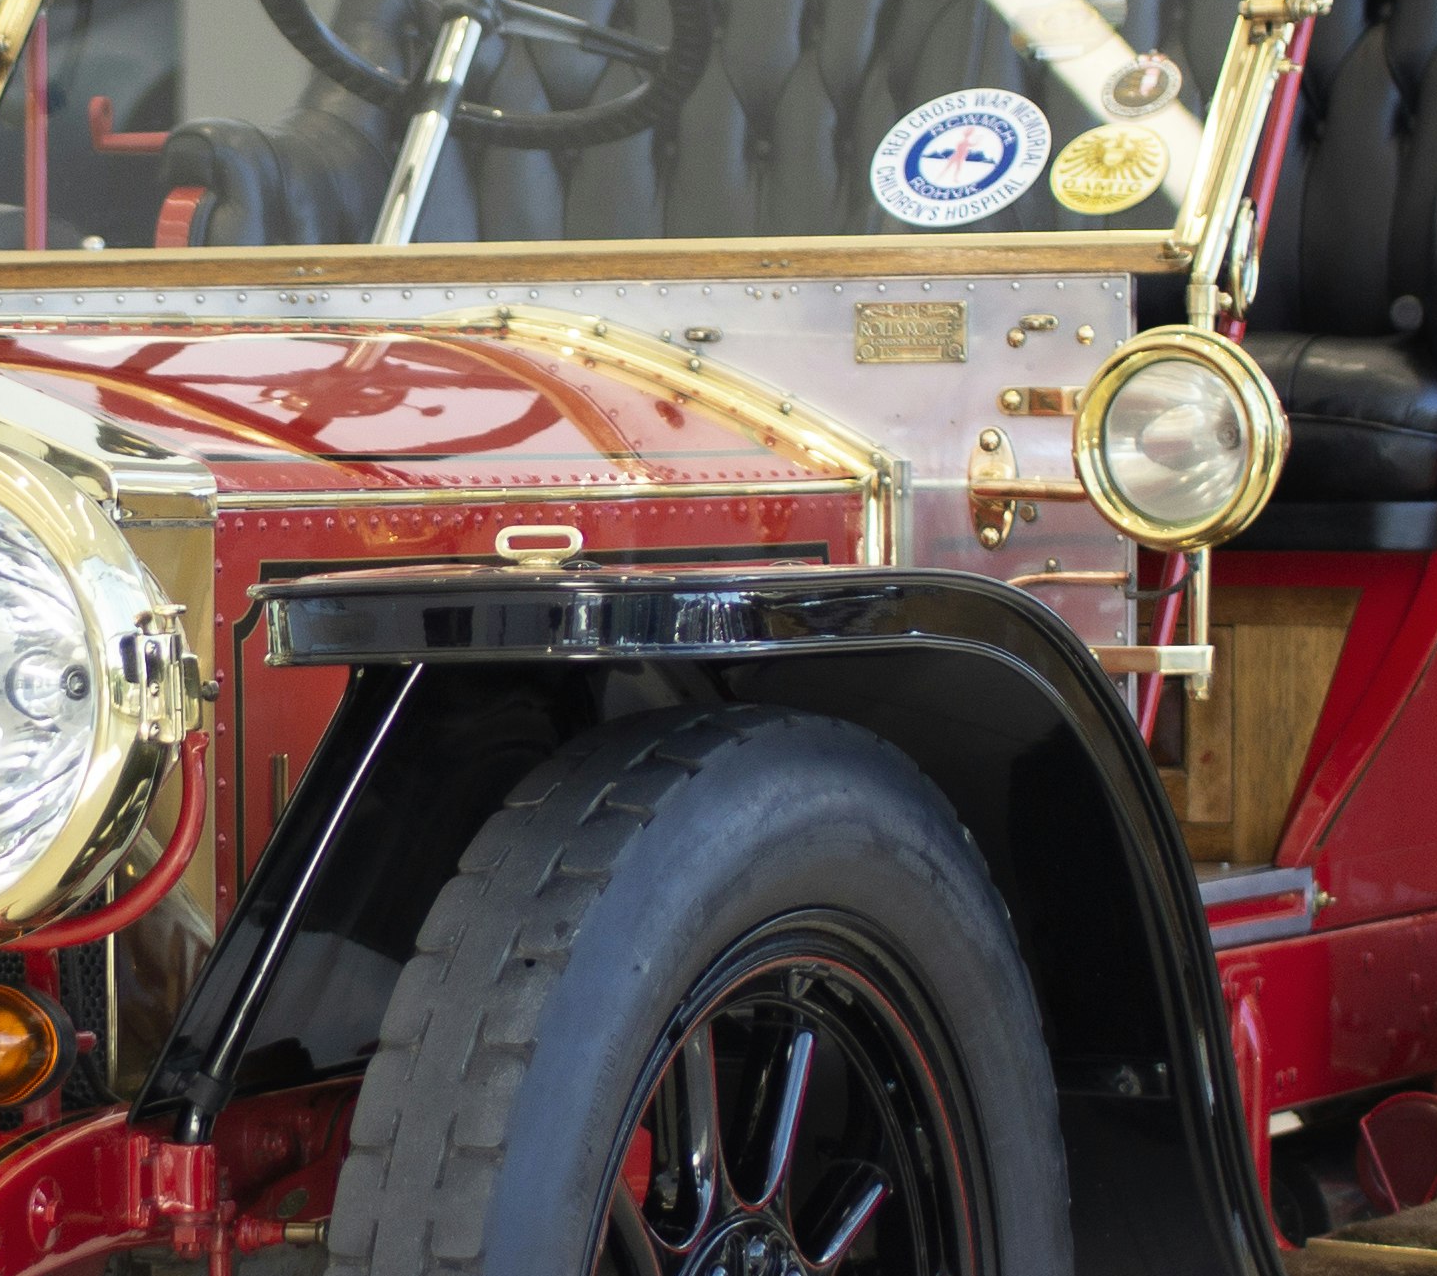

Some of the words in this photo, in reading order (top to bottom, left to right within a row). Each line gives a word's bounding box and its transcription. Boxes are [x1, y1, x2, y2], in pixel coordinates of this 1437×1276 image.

[882, 129, 911, 156] RED
[909, 94, 967, 129] CROSS
[975, 92, 1013, 109] WAR
[1012, 101, 1046, 169] MEMORIAL
[945, 178, 1027, 221] HOSPITAL
